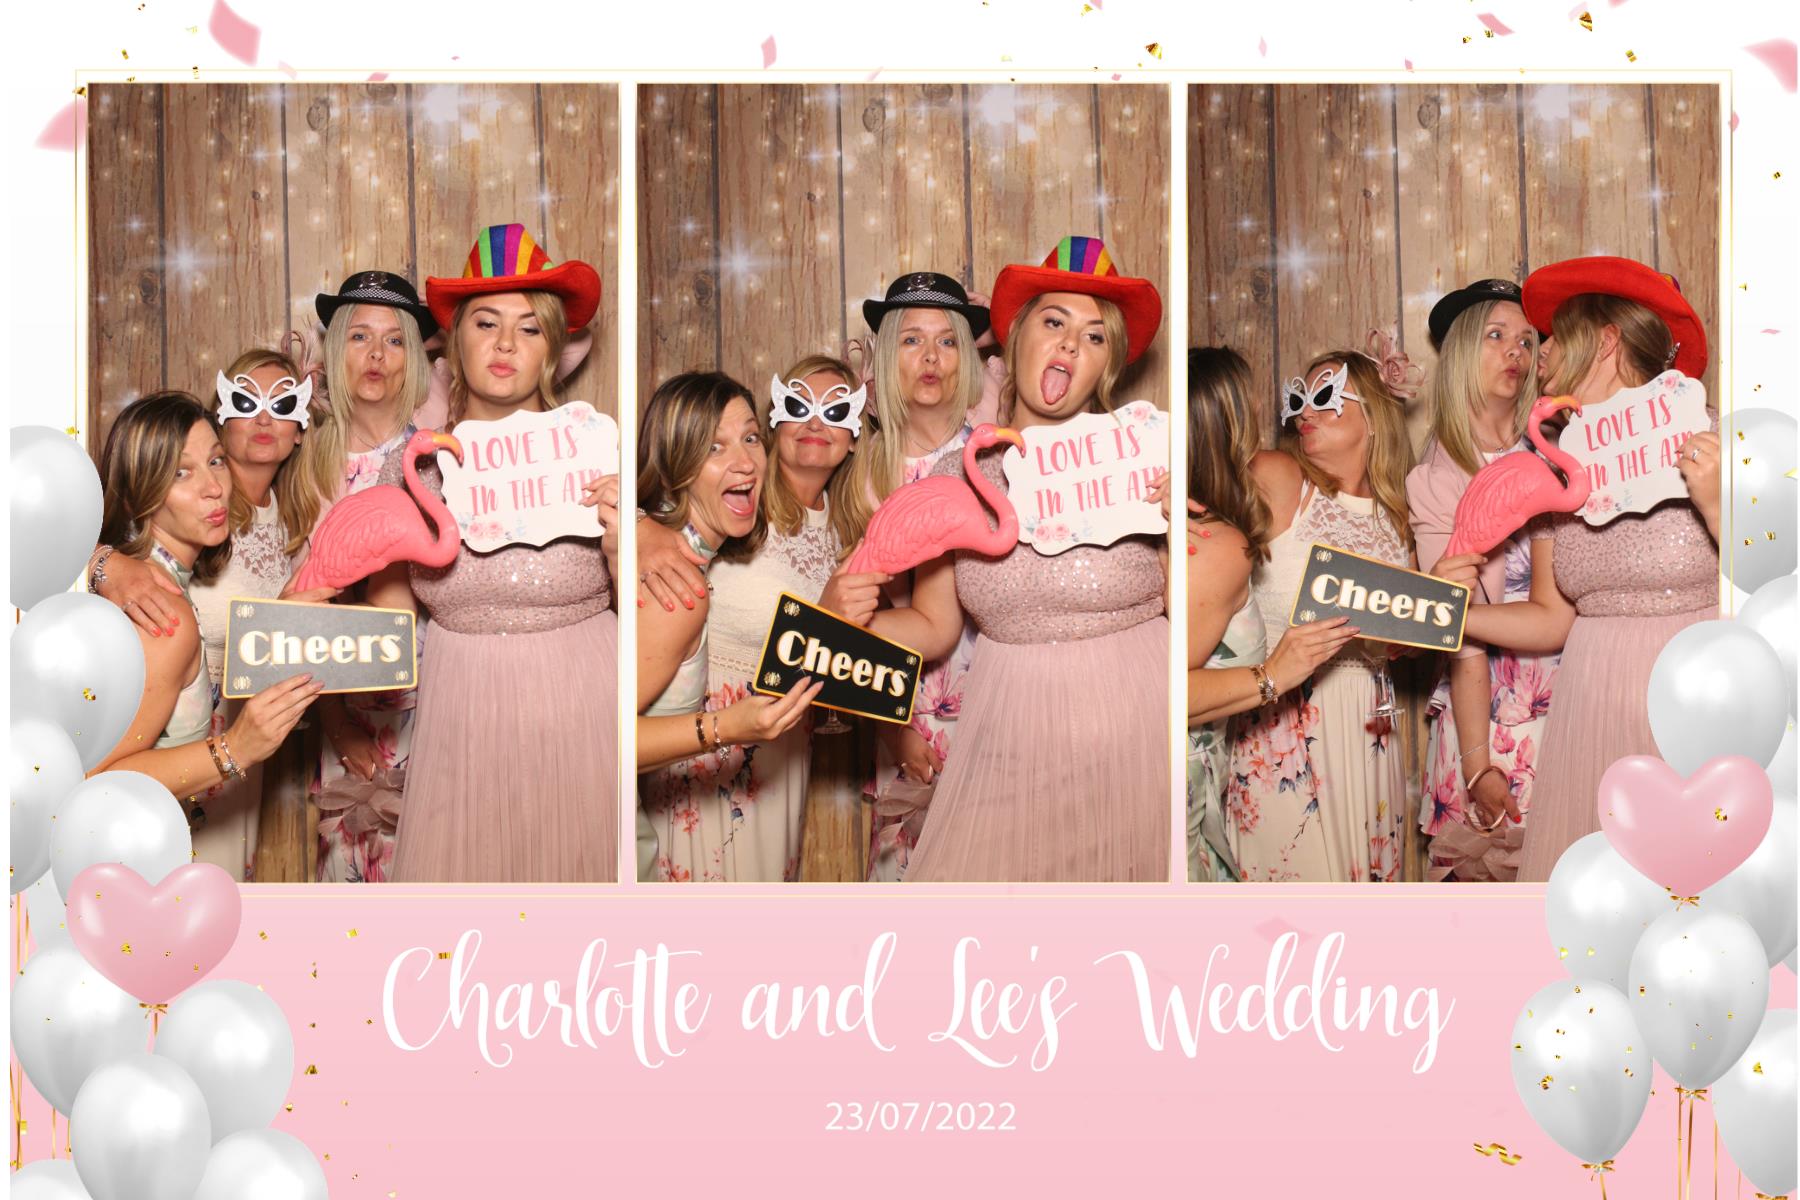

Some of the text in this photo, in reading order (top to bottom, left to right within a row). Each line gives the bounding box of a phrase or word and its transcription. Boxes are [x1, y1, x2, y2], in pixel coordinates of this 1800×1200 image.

[1585, 394, 1672, 452] LOVE IS
[471, 425, 578, 472] LOVE IS
[1036, 424, 1141, 476] LOVE IS
[1616, 445, 1652, 482] THE
[507, 475, 551, 511] THE
[1072, 475, 1116, 512] THE
[1311, 573, 1454, 627] Cheers
[239, 630, 402, 666] Cheers
[776, 630, 907, 697] Cheers
